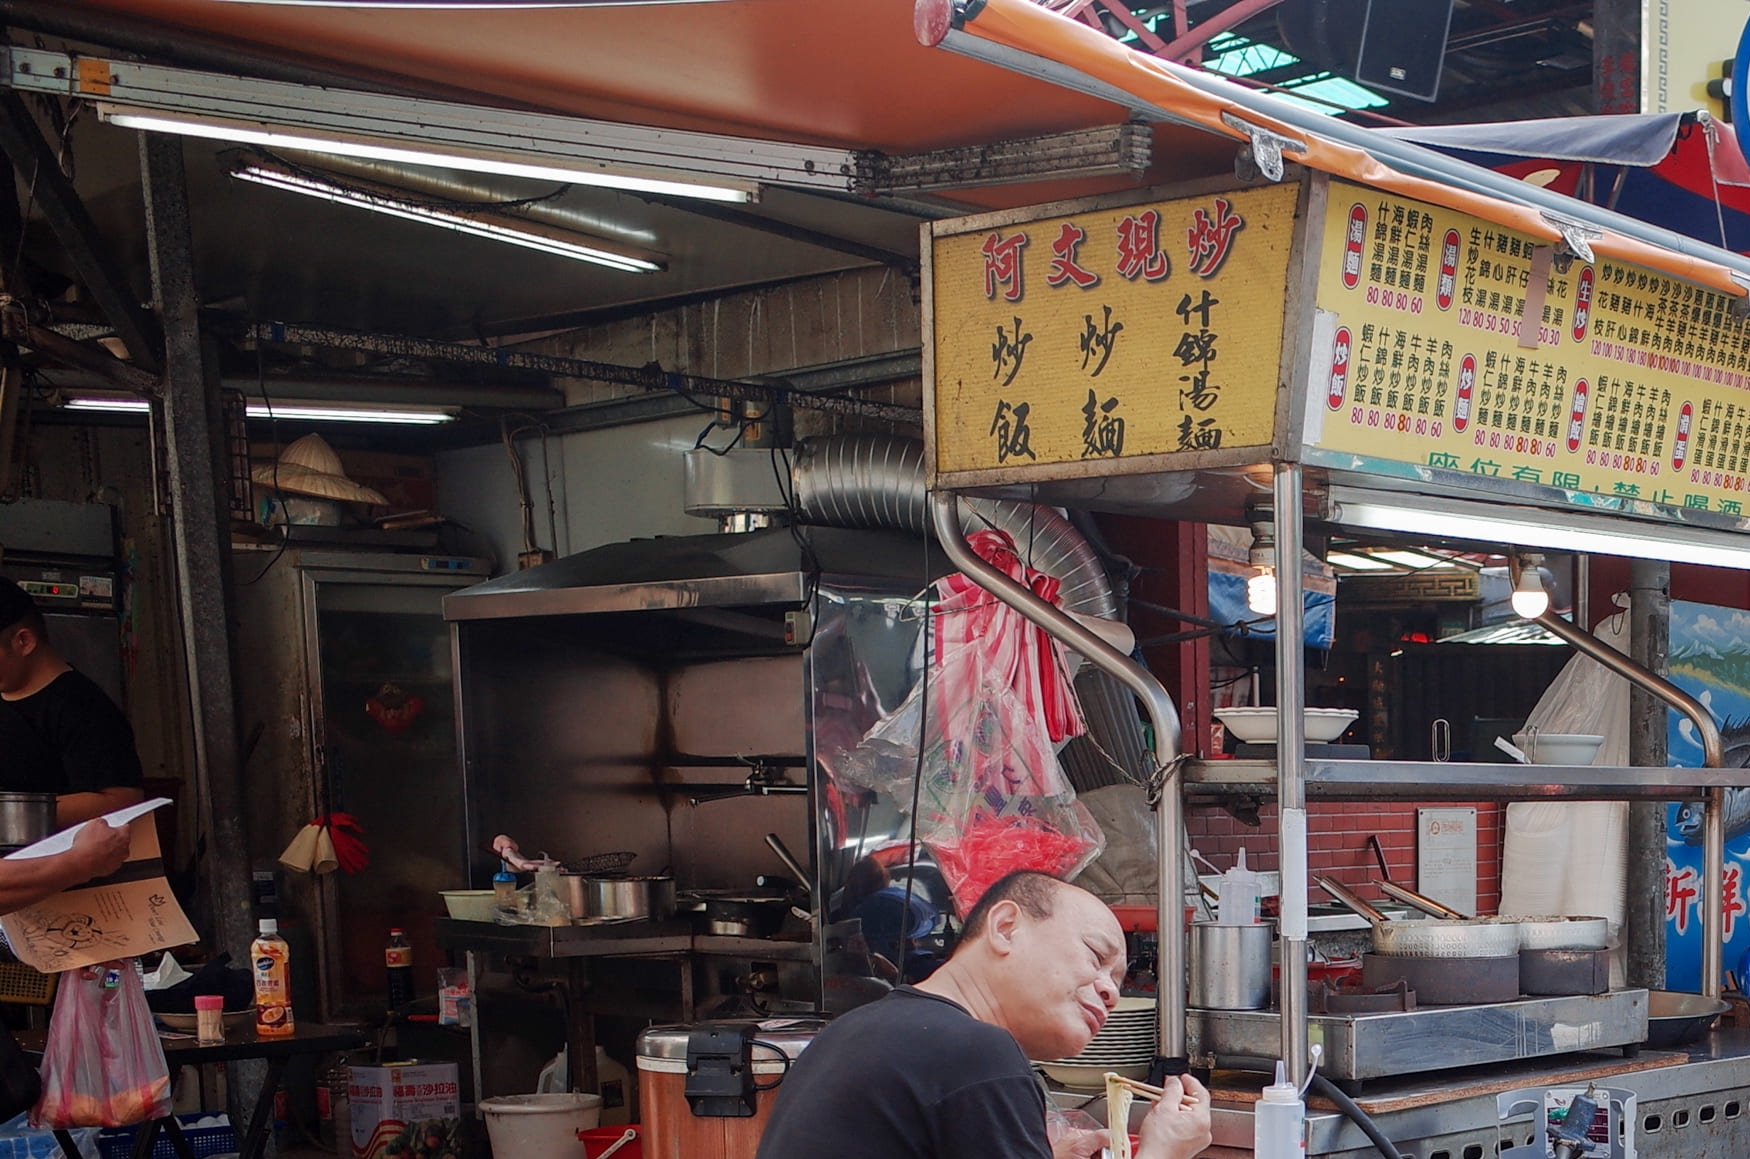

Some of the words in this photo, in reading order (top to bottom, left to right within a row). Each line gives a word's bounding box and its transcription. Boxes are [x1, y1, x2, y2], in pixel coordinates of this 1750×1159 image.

[981, 199, 1244, 300] 阿文現炒
[1345, 218, 1364, 275] 湯麵
[1370, 200, 1390, 283] 什錦湯麵
[1385, 205, 1405, 286] 海鮮湯麵
[1399, 208, 1419, 289] 蝦仁湯麵
[1413, 212, 1433, 293] 肉絲湯麵
[1463, 227, 1481, 305] 生炒花枝
[1475, 229, 1495, 308] 什錦湯
[1489, 233, 1508, 311] 豬心湯
[1501, 237, 1521, 314] 豬肝湯
[1367, 286, 1379, 304] 80
[1382, 289, 1394, 307] 80
[1396, 292, 1408, 310] 80
[1411, 296, 1423, 314] 60
[1459, 307, 1471, 326] 120
[1473, 311, 1484, 328] 80
[1485, 314, 1497, 331] 50
[1499, 317, 1510, 334] 50
[1537, 327, 1548, 343] 50
[1549, 329, 1560, 346] 30
[1574, 280, 1591, 329] 生炒
[1594, 264, 1612, 336] 炒花枝
[1605, 266, 1624, 339] 炒豬肝
[1618, 269, 1636, 341] 炒豬心
[1629, 272, 1648, 344] 炒什錦
[1640, 275, 1659, 347] 炒海鮮
[1652, 279, 1670, 350] 沙茶牛肉
[1663, 281, 1682, 353] 沙茶羊肉
[1674, 284, 1693, 356] 沙茶豬肉
[1080, 304, 1125, 458] 炒麵
[1173, 290, 1221, 451] 什錦湯麵
[1331, 342, 1348, 396] 炒飯
[1353, 323, 1374, 403] 蝦仁炒飯
[1370, 326, 1390, 406] 什錦炒飯
[1386, 330, 1407, 409] 海鮮炒飯
[1402, 333, 1422, 412] 牛肉炒飯
[1418, 336, 1437, 415] 羊肉炒飯
[1433, 340, 1453, 418] 肉絲炒飯
[1592, 339, 1601, 355] 120
[1603, 342, 1612, 358] 100
[990, 317, 1036, 464] 炒飯
[1351, 407, 1363, 424] 80
[1368, 410, 1379, 427] 80
[1384, 413, 1396, 430] 80
[1397, 414, 1411, 432] 80
[1416, 418, 1427, 435] 80
[1431, 421, 1442, 438] 60
[1456, 367, 1473, 420] 炒麵
[1477, 349, 1497, 426] 蝦仁炒麵
[1491, 353, 1511, 428] 什錦炒麵
[1506, 356, 1526, 431] 海鮮炒麵
[1520, 359, 1539, 434] 牛肉炒麵
[1534, 362, 1553, 436] 羊肉炒麵
[1548, 365, 1567, 438] 肉絲炒麵
[1474, 429, 1486, 446] 80
[1490, 432, 1500, 448] 80
[1504, 434, 1514, 451] 80
[1516, 436, 1529, 453] 80
[1530, 438, 1542, 455] 80
[1546, 442, 1556, 458] 60
[1586, 449, 1596, 464] 80
[1600, 452, 1609, 467] 80
[1613, 454, 1622, 469] 80
[1624, 456, 1635, 471] 80
[1636, 457, 1647, 473] 80
[1650, 461, 1659, 475] 60
[1691, 468, 1700, 483] 80
[1702, 470, 1711, 485] 80
[1714, 472, 1722, 487] 80
[1723, 474, 1734, 489] 80
[1734, 476, 1745, 491] 80
